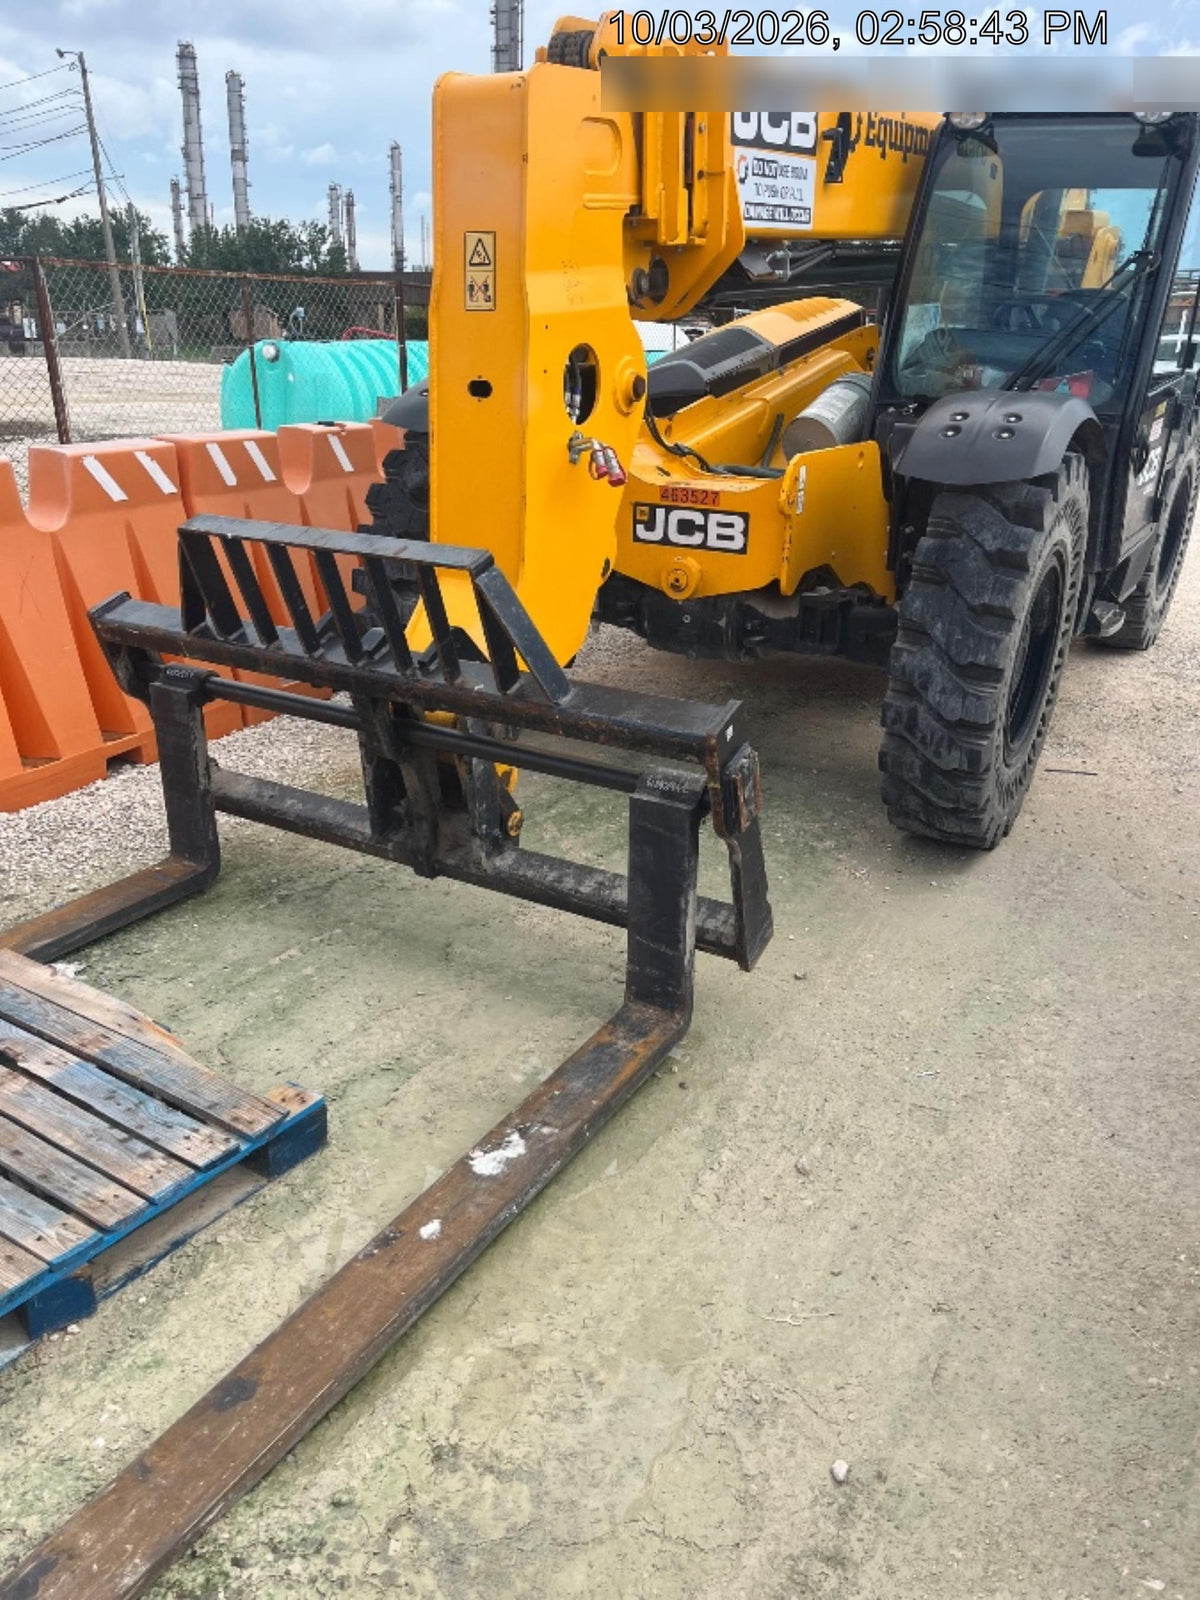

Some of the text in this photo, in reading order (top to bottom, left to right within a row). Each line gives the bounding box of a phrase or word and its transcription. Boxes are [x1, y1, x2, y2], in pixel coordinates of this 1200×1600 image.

[865, 111, 935, 163] Equipm
[660, 487, 720, 506] 463527
[635, 507, 746, 551] JCB
